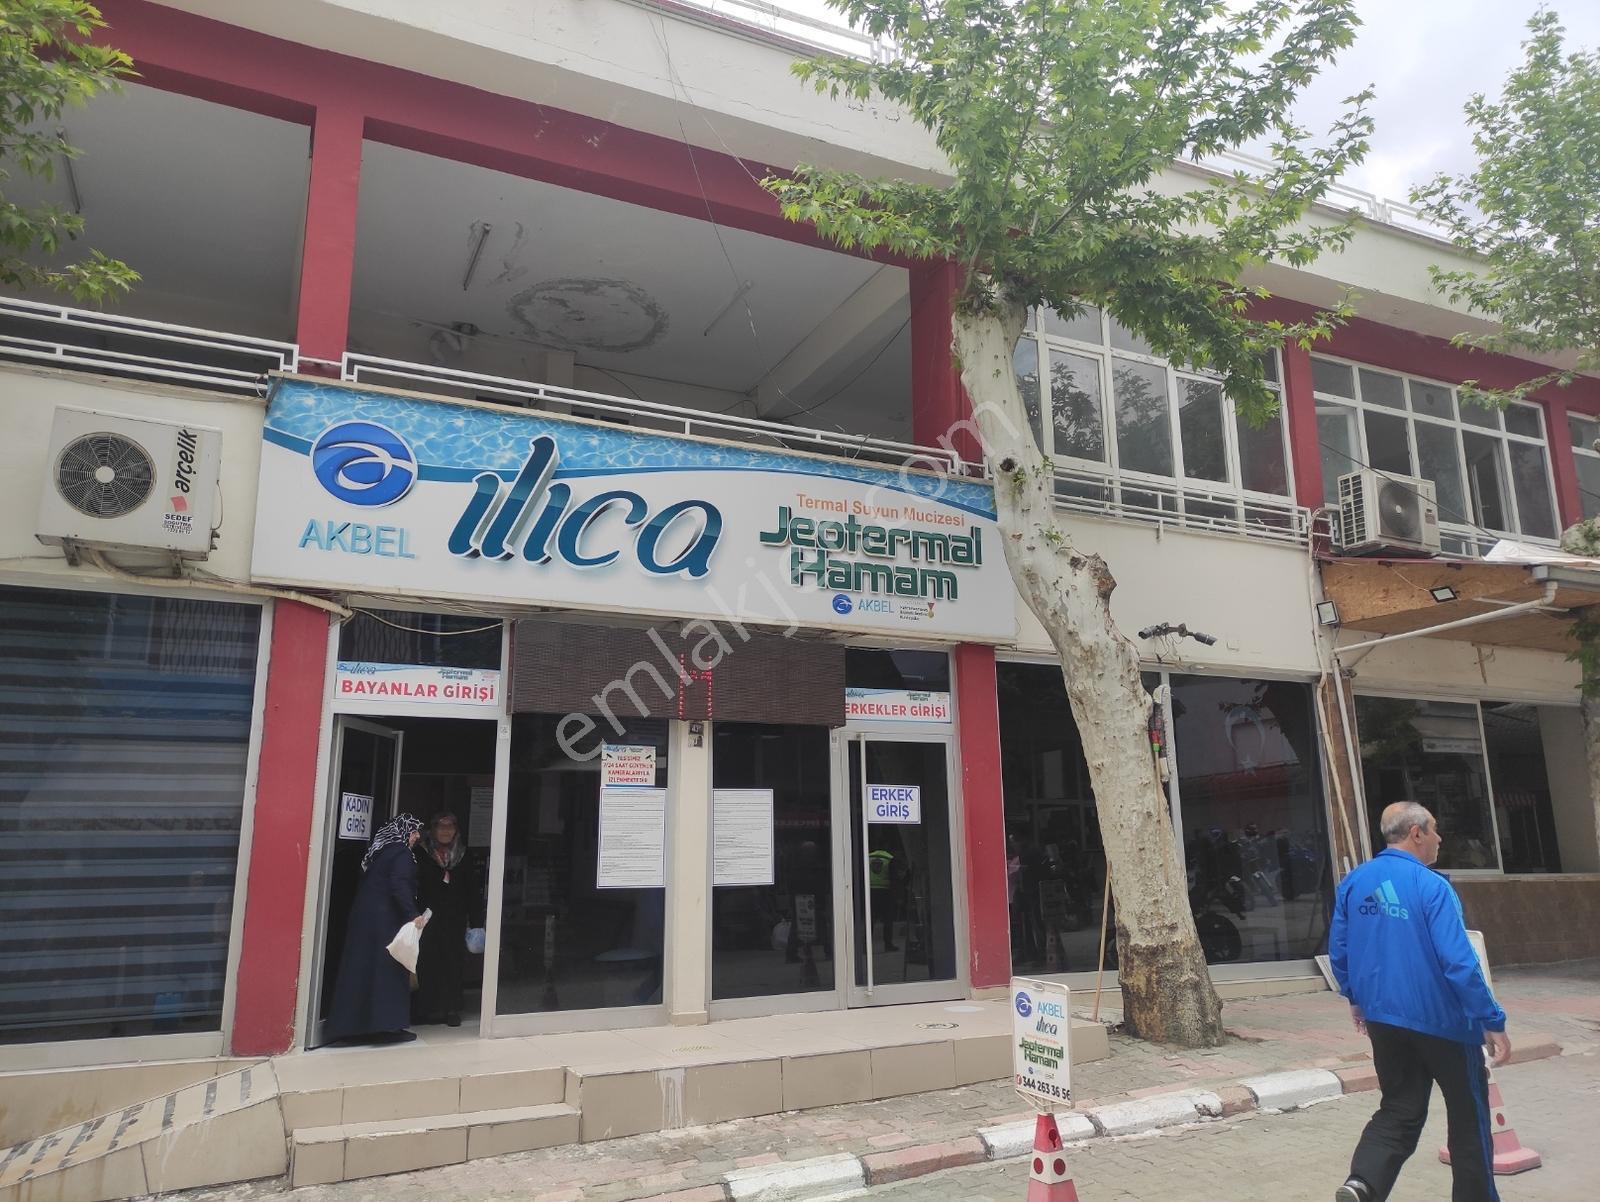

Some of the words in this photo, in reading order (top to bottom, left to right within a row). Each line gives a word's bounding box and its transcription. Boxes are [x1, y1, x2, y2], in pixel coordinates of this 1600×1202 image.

[174, 429, 197, 493] arçelik
[164, 513, 193, 523] SEDEF
[796, 494, 848, 513] Termal
[852, 501, 899, 519] Suyun
[904, 510, 965, 526] Mucizesi
[298, 518, 415, 559] AKBEL
[759, 505, 983, 567] Jeotermal
[789, 546, 959, 600] Hamam
[858, 598, 895, 613] AKBEL
[341, 679, 438, 698] BAYANLAR
[443, 682, 494, 702] GİRİŞİ
[845, 703, 907, 716] ERKEKLER
[910, 703, 946, 718] GİRİŞİ
[871, 788, 914, 801] ERKEK
[346, 797, 370, 814] KADIN
[876, 801, 910, 820] GİRİŞ
[346, 814, 366, 834] GİRİŞ
[1037, 1001, 1065, 1019] AKBEL
[1019, 1037, 1064, 1059] Jeotermal
[1024, 1049, 1059, 1070] Hamam
[1022, 1075, 1036, 1090] 344
[1037, 1080, 1051, 1095] 263
[1051, 1084, 1060, 1098] 36
